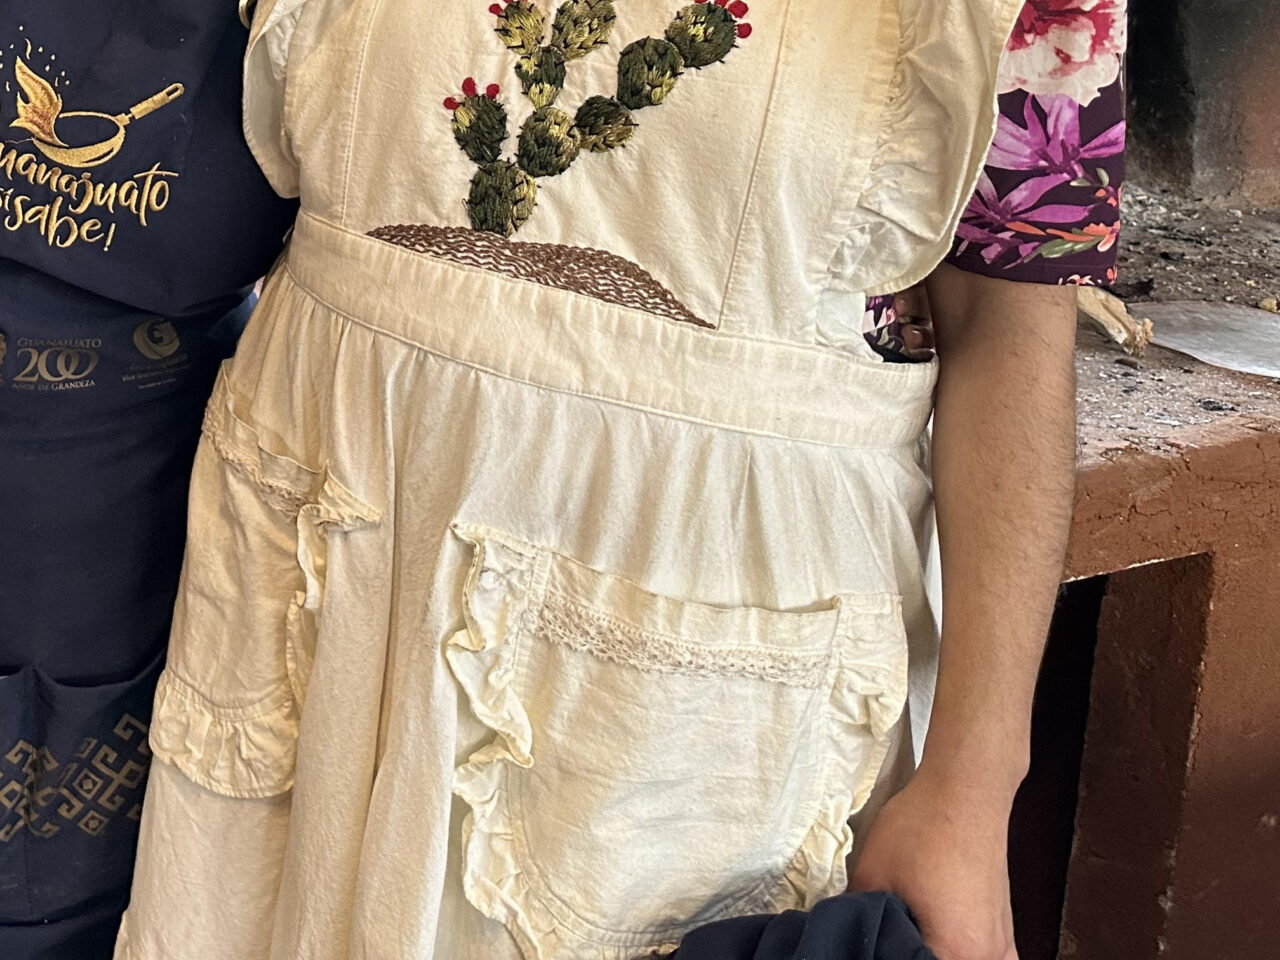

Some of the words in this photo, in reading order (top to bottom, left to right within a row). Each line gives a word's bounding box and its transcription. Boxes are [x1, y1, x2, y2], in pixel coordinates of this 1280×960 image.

[17, 336, 102, 349] GUANAJUATO
[12, 346, 100, 383] 200
[50, 379, 97, 392] GRANDEZA
